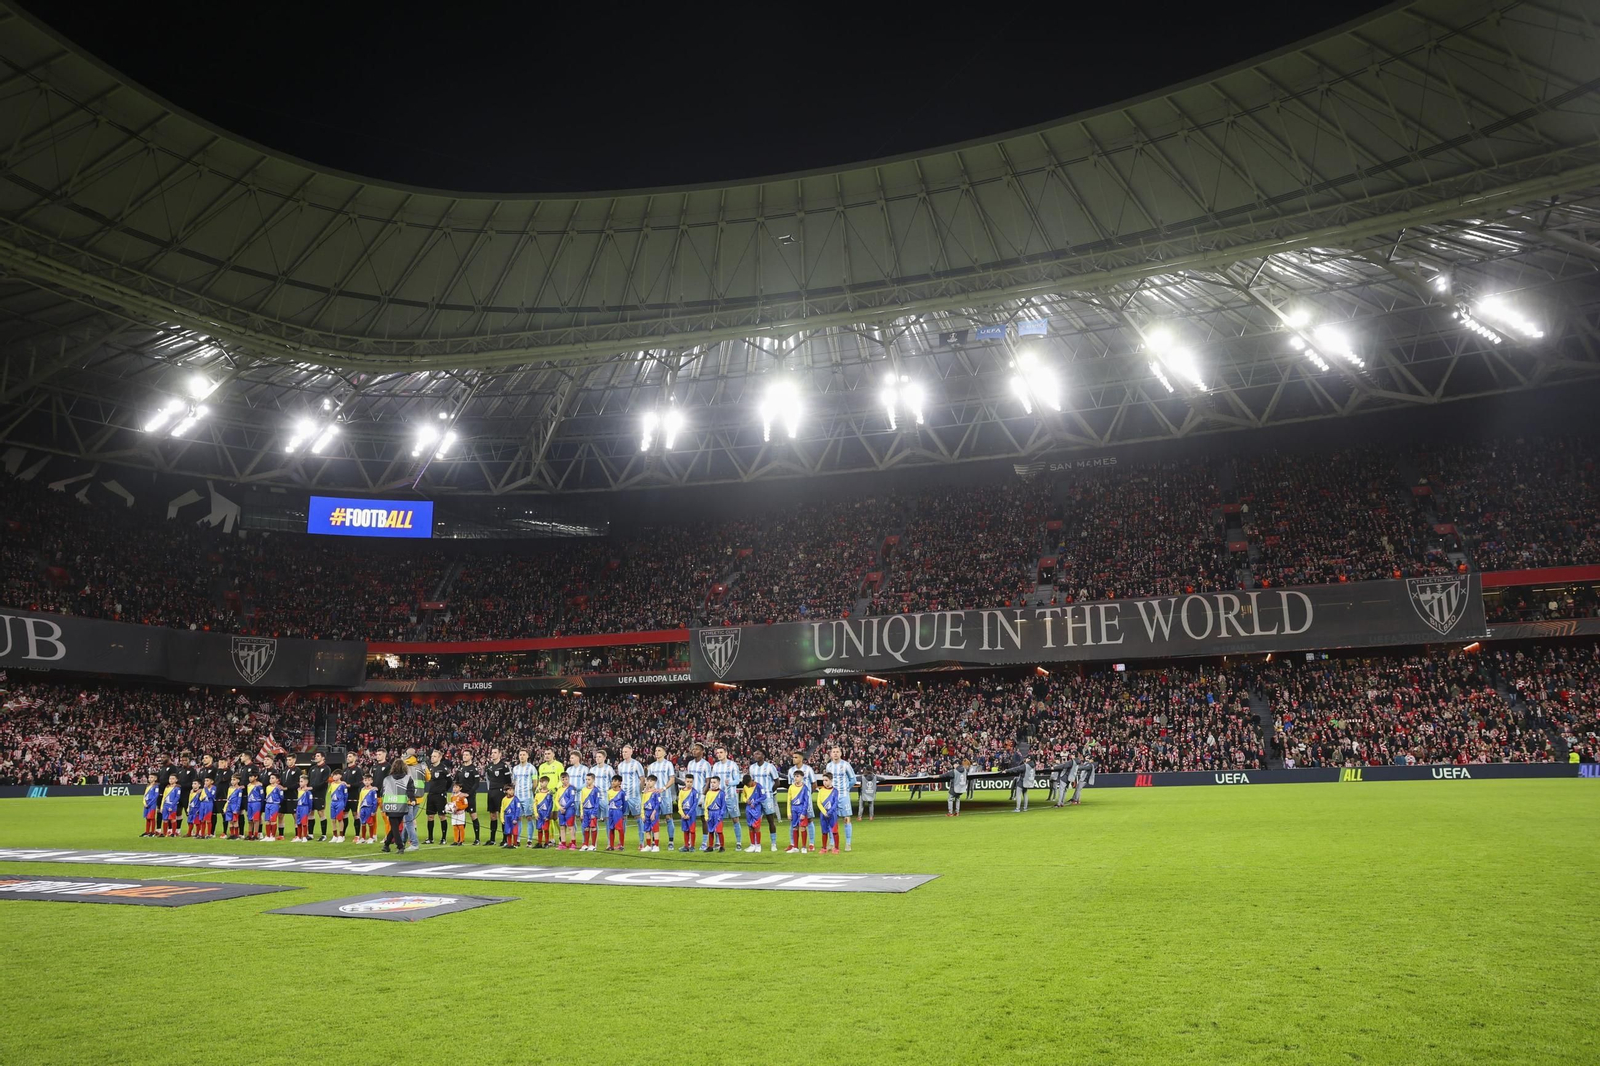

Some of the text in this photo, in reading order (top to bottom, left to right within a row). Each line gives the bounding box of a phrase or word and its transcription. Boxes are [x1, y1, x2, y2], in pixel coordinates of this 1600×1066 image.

[1050, 462, 1072, 472] SAN
[329, 507, 413, 529] #FOOTBALL
[1411, 577, 1444, 585] ATHLETIC
[811, 590, 1314, 663] UNIQUE IN THE WORLD
[1429, 614, 1456, 632] BILBAO
[618, 676, 637, 684] UEFA
[639, 674, 667, 683] EUROPA
[463, 682, 493, 690] FLIXBUS
[1343, 768, 1363, 782] ALL
[1432, 767, 1471, 779] UEFA
[1580, 765, 1600, 778] ALL
[1135, 774, 1153, 787] ALL
[1215, 773, 1250, 784] UEFA
[30, 787, 48, 797] ALL
[103, 787, 130, 797] UEFA
[51, 852, 397, 872] EUROPA
[397, 864, 868, 888] LEAGUE
